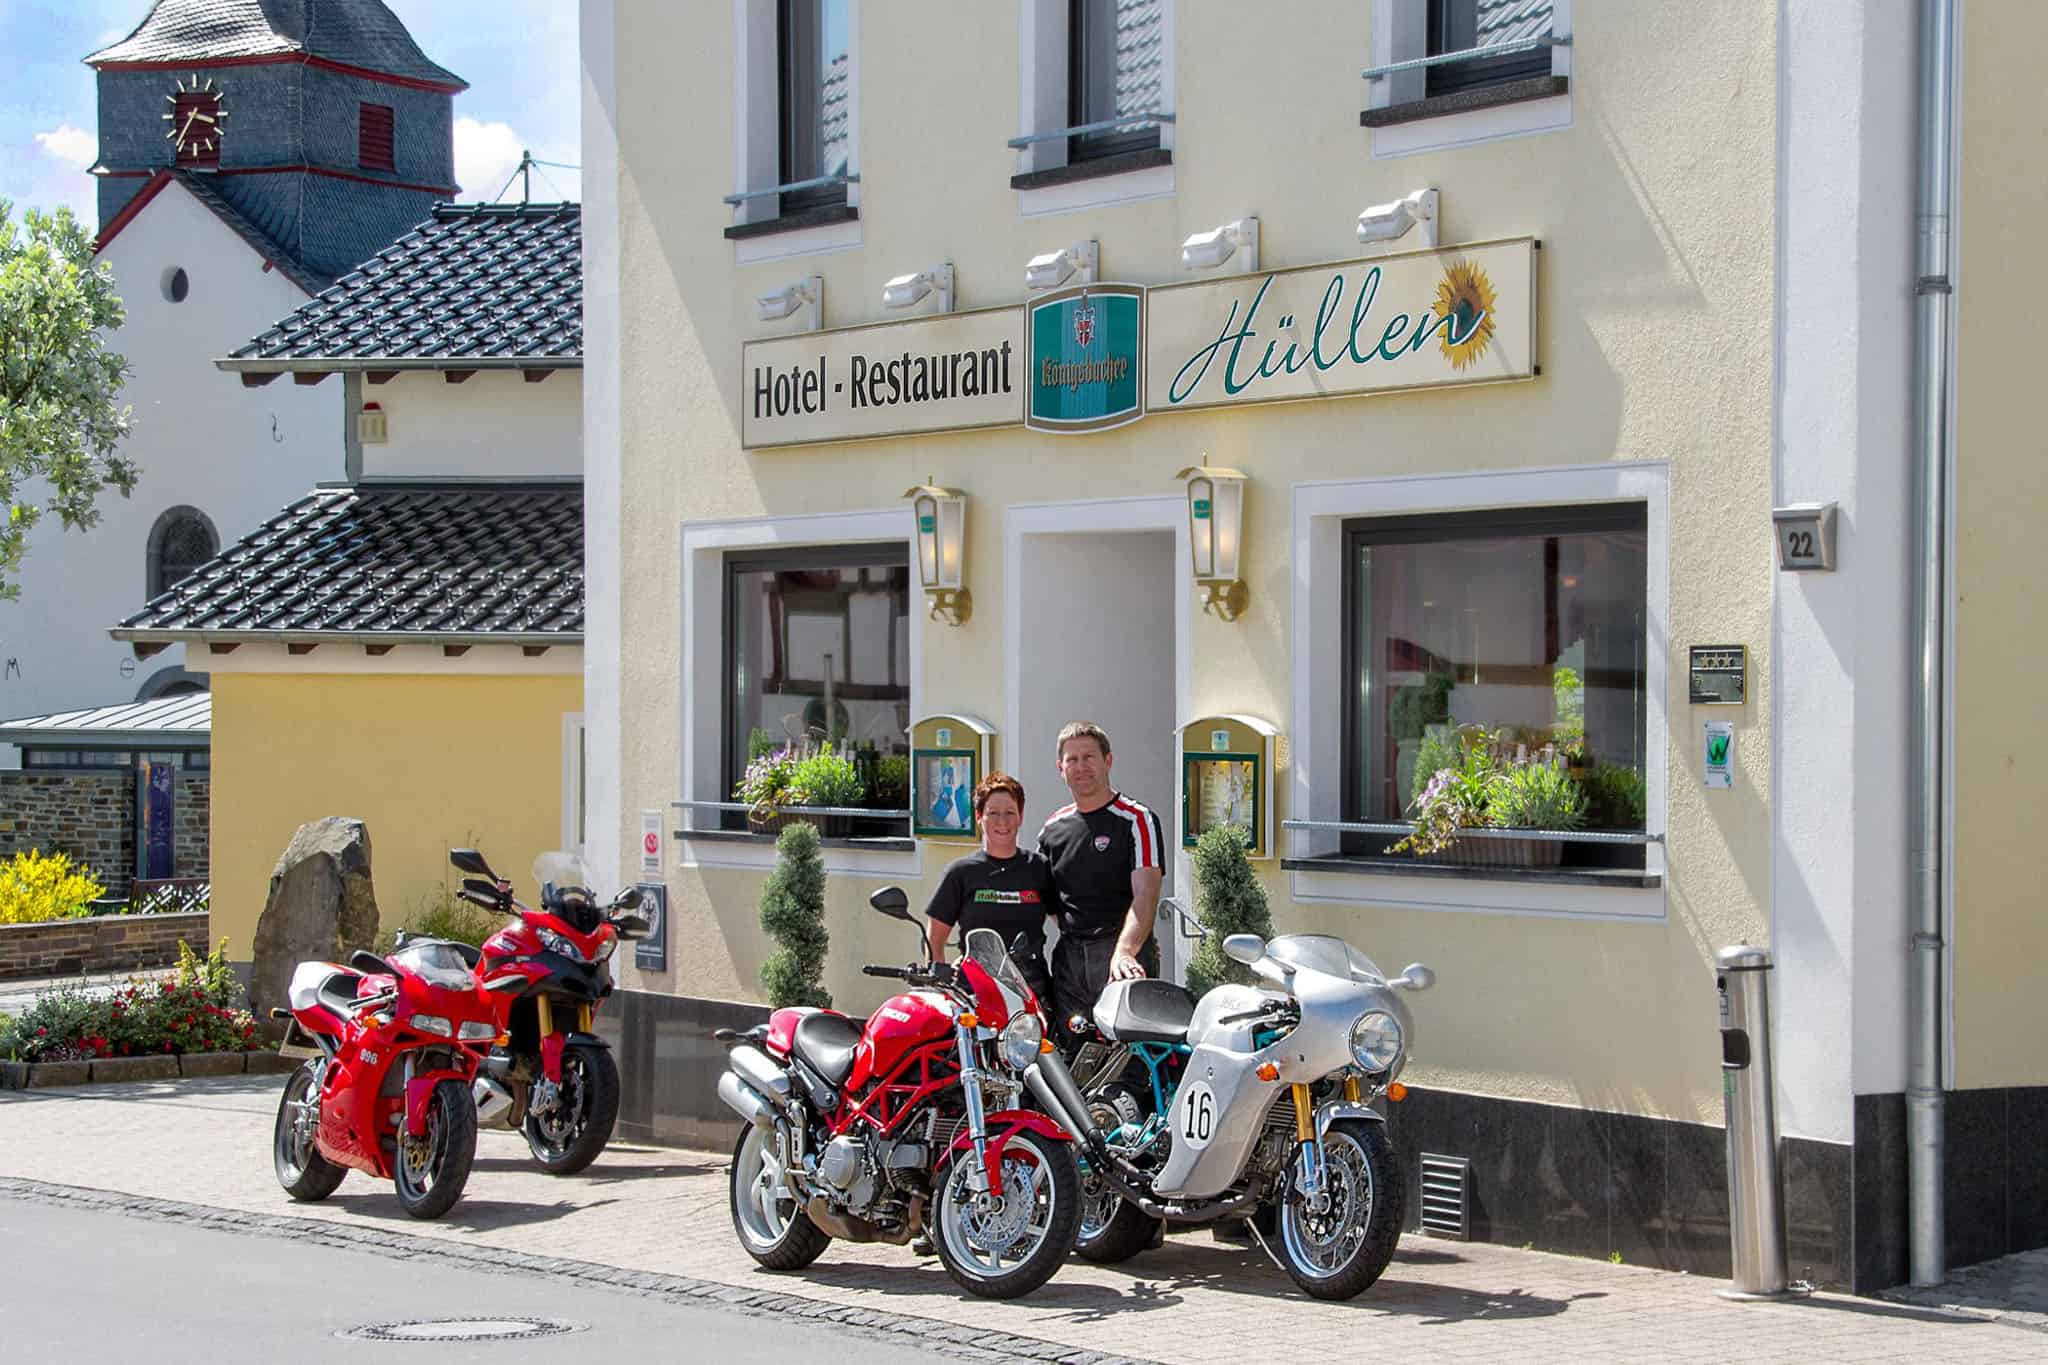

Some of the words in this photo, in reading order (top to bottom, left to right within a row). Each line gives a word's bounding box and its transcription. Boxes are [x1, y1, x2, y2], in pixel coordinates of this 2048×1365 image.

[1168, 266, 1488, 404] Hüllen
[754, 355, 827, 419] Hotel
[850, 339, 1012, 409] Restaurant
[1041, 352, 1128, 393] Königsbacher
[1789, 531, 1815, 558] 22
[1185, 1090, 1212, 1141] 16
